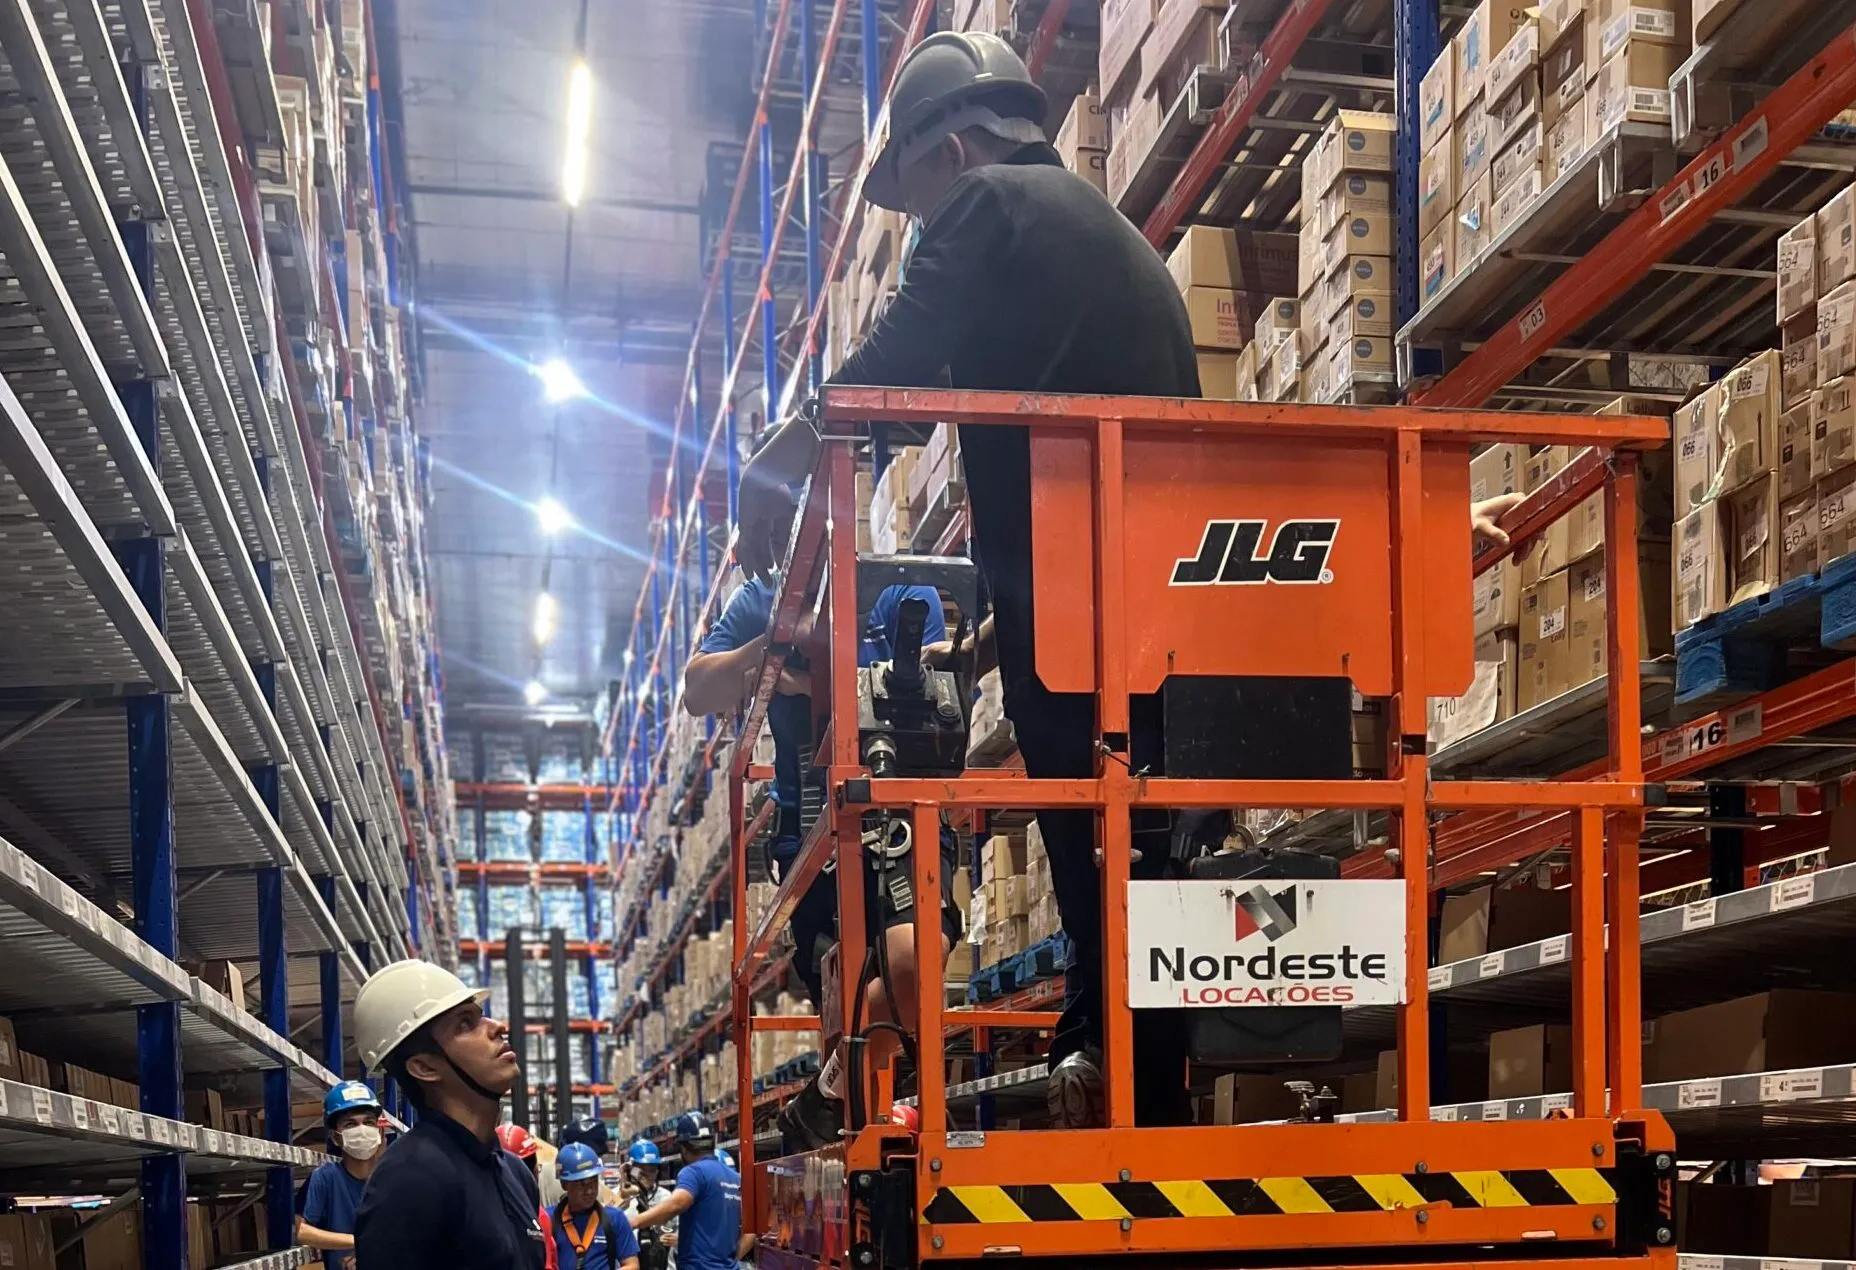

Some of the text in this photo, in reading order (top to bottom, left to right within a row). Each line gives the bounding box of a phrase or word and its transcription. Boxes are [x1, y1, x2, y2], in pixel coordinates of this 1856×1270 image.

[1701, 161, 1719, 189] 16
[1531, 308, 1544, 327] 03
[1820, 500, 1845, 525] 664
[1784, 523, 1807, 552] 664
[1169, 519, 1341, 586] JLG
[1437, 697, 1456, 722] 710
[1693, 722, 1722, 751] 16
[1149, 945, 1386, 982] Nordeste
